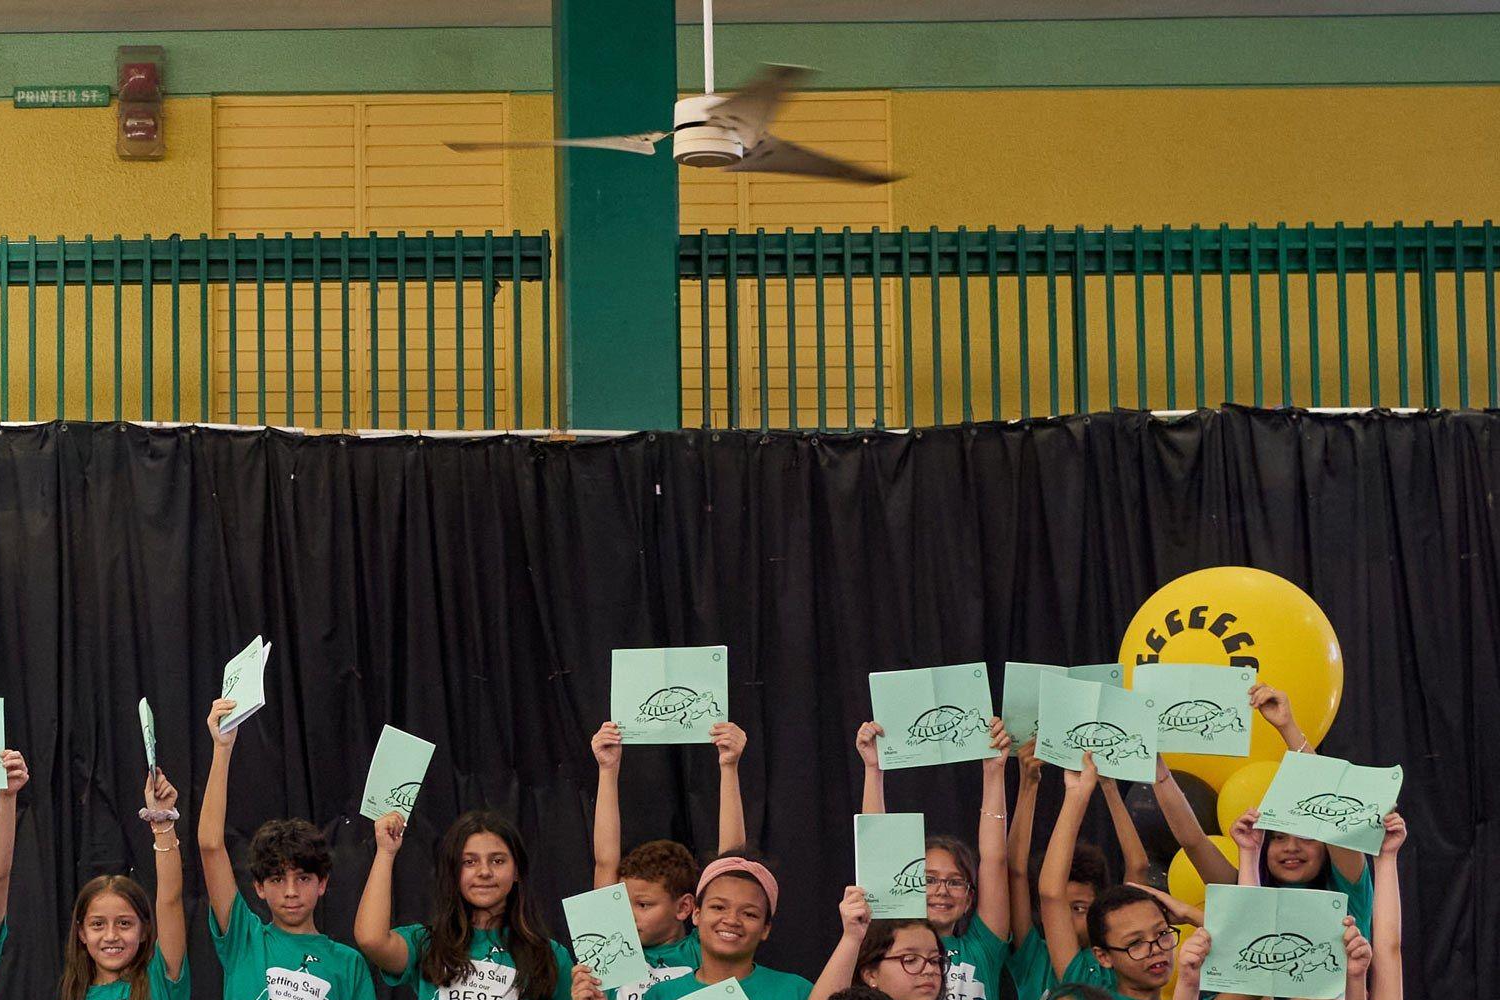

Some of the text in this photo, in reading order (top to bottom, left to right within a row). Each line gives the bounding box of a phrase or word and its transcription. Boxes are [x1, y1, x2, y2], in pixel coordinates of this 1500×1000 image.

[17, 90, 75, 103] PRINTER
[487, 970, 507, 985] Sail
[266, 975, 320, 998] Setting Sail
[283, 990, 292, 998] do
